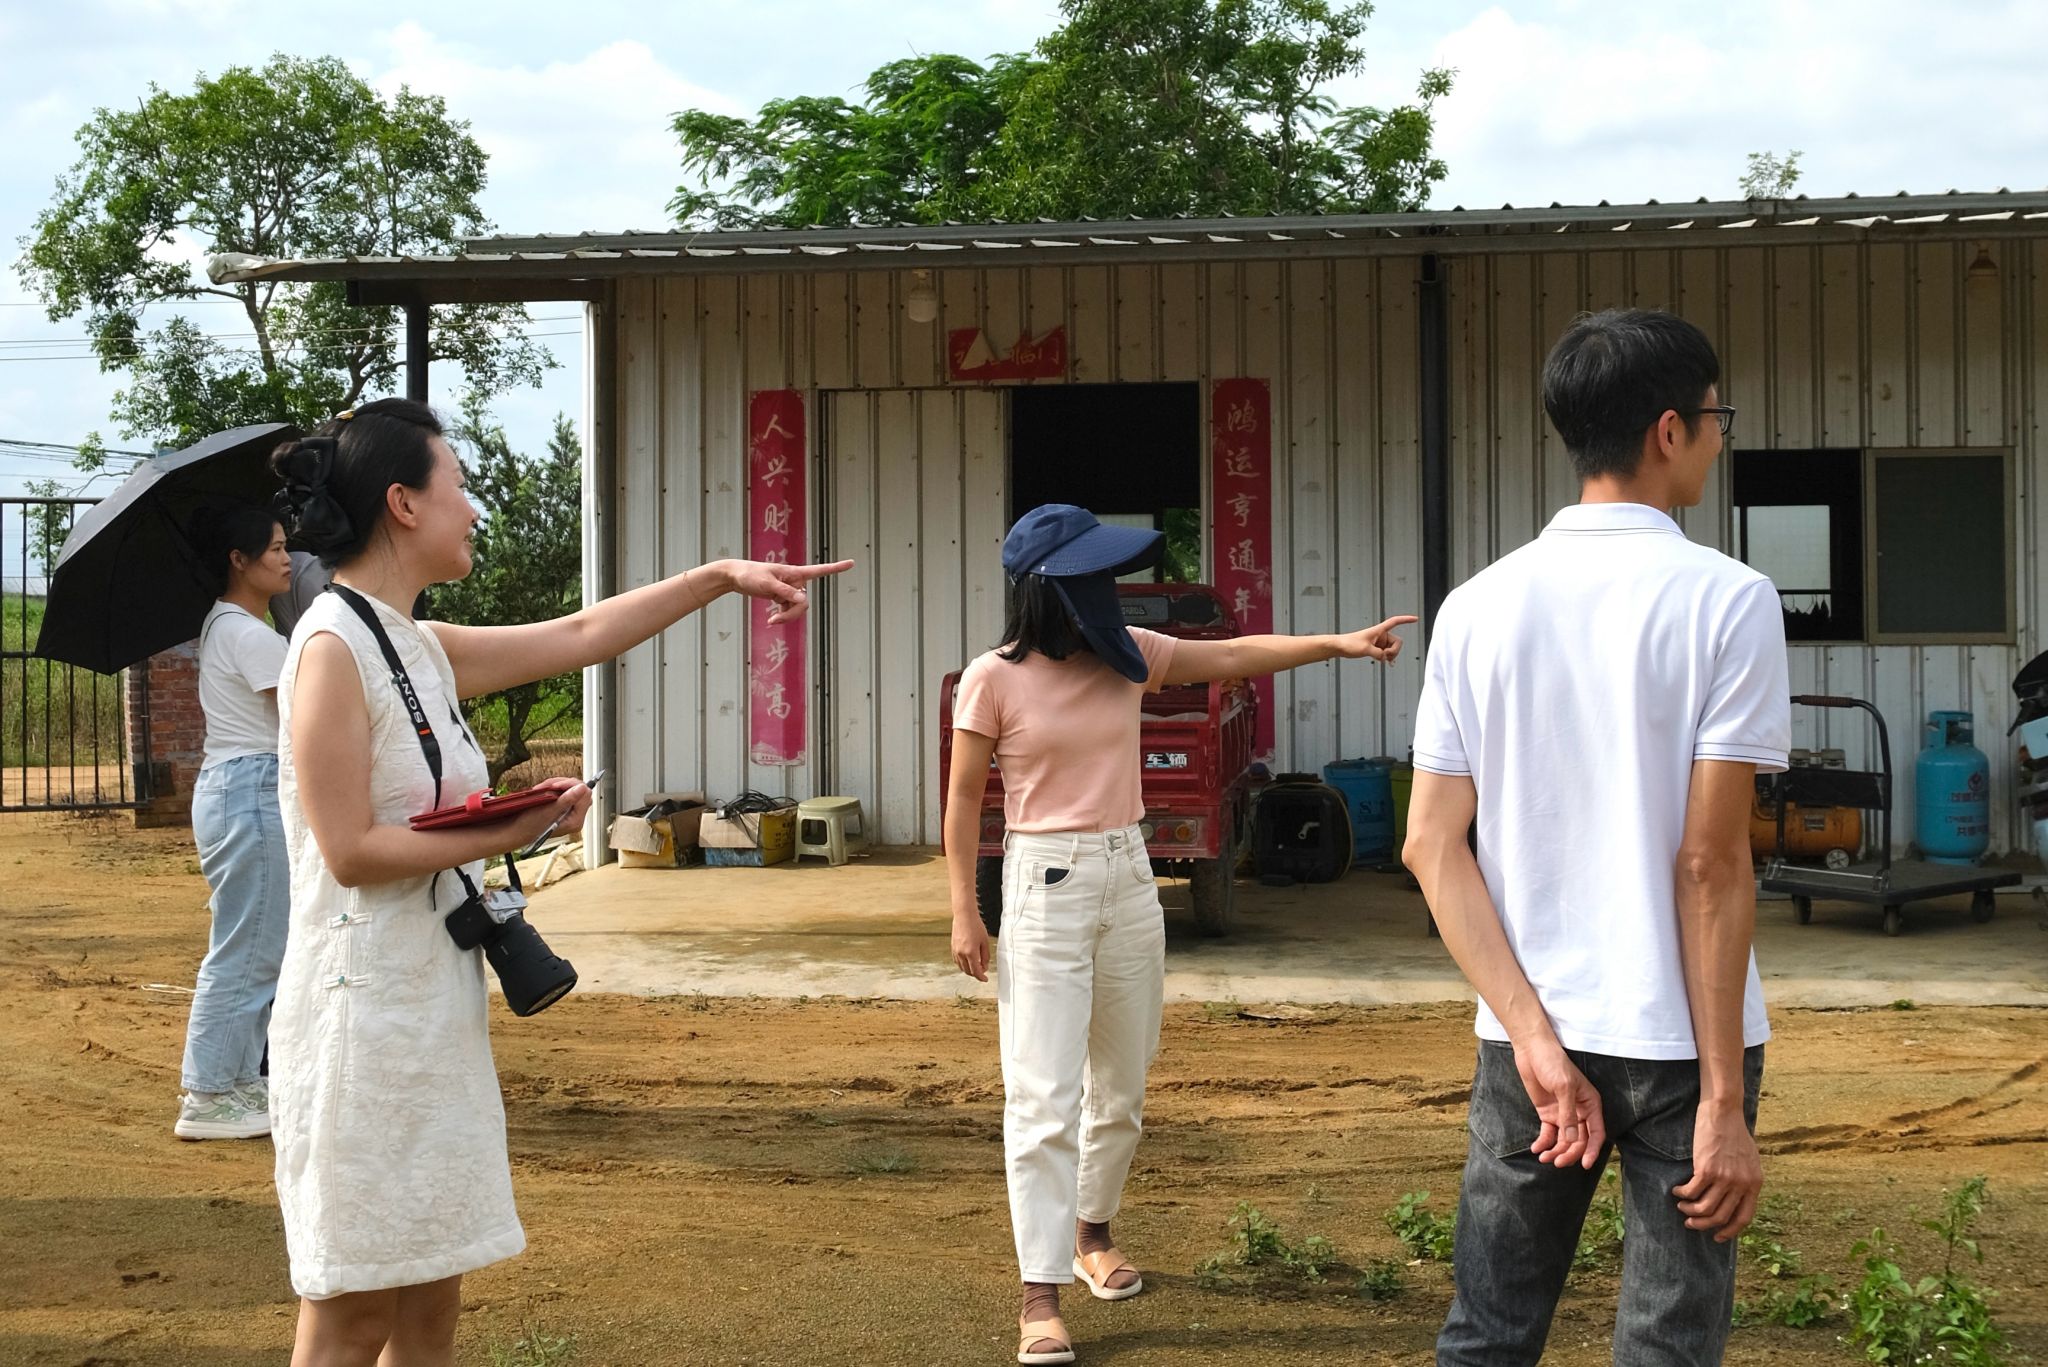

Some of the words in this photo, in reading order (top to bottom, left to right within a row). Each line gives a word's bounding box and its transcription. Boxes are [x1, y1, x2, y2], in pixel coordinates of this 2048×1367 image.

[953, 336, 1061, 367] 临门
[762, 413, 797, 721] 人兴财步高
[395, 669, 424, 724] SONY
